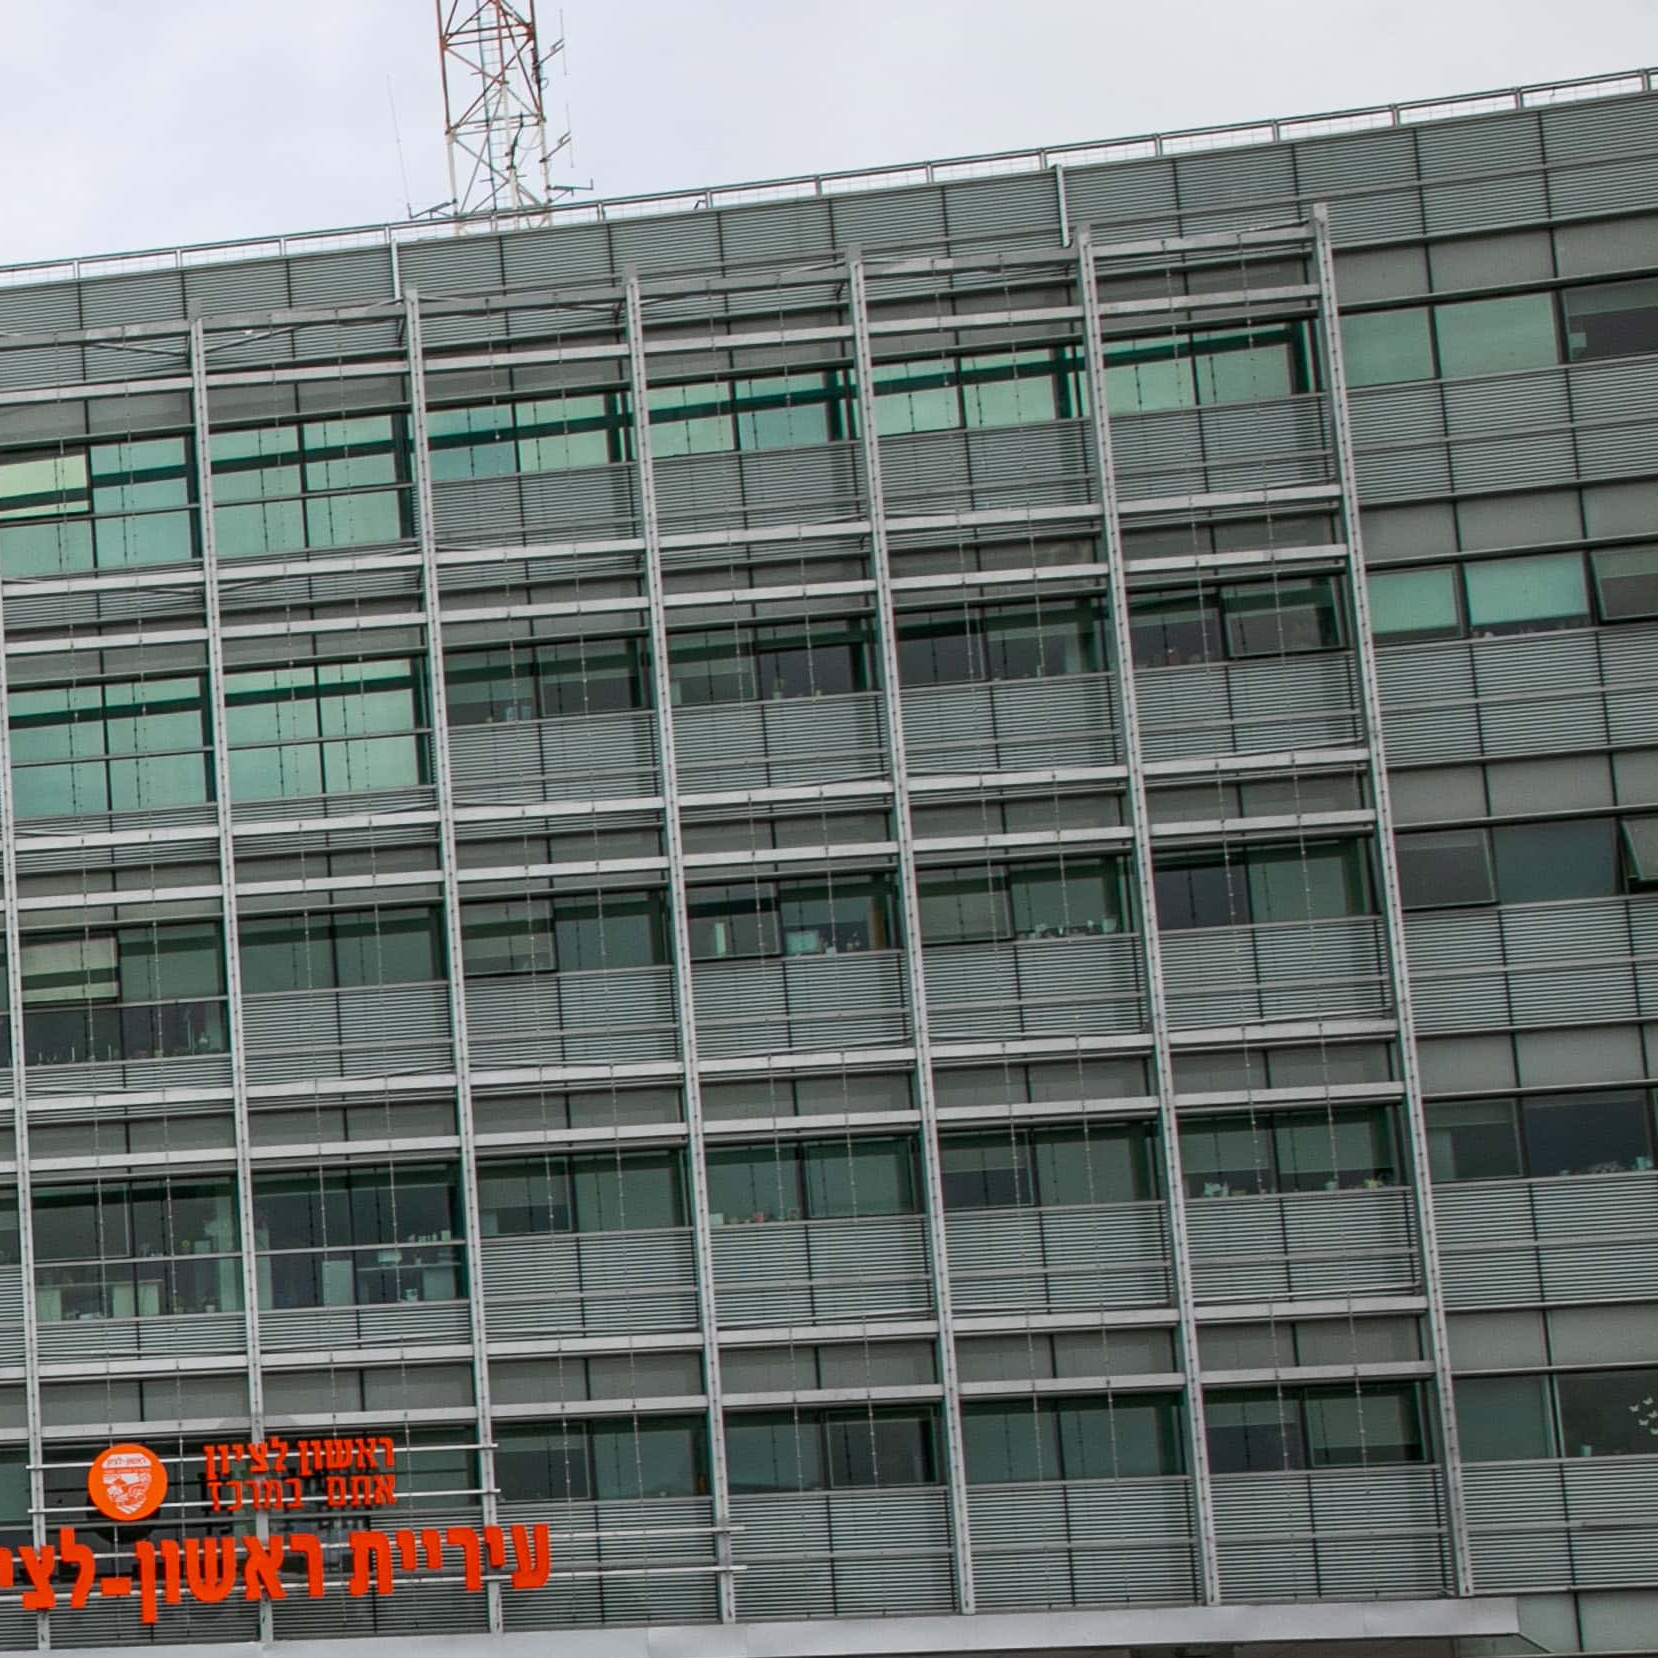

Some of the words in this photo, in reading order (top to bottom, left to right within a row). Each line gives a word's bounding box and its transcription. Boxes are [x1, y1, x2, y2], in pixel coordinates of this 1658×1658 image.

[203, 1435, 289, 1481] לציון
[296, 1436, 396, 1477] ראשון
[207, 1477, 305, 1512] במרכז
[326, 1473, 396, 1507] אתם
[347, 1522, 552, 1598] עיריית
